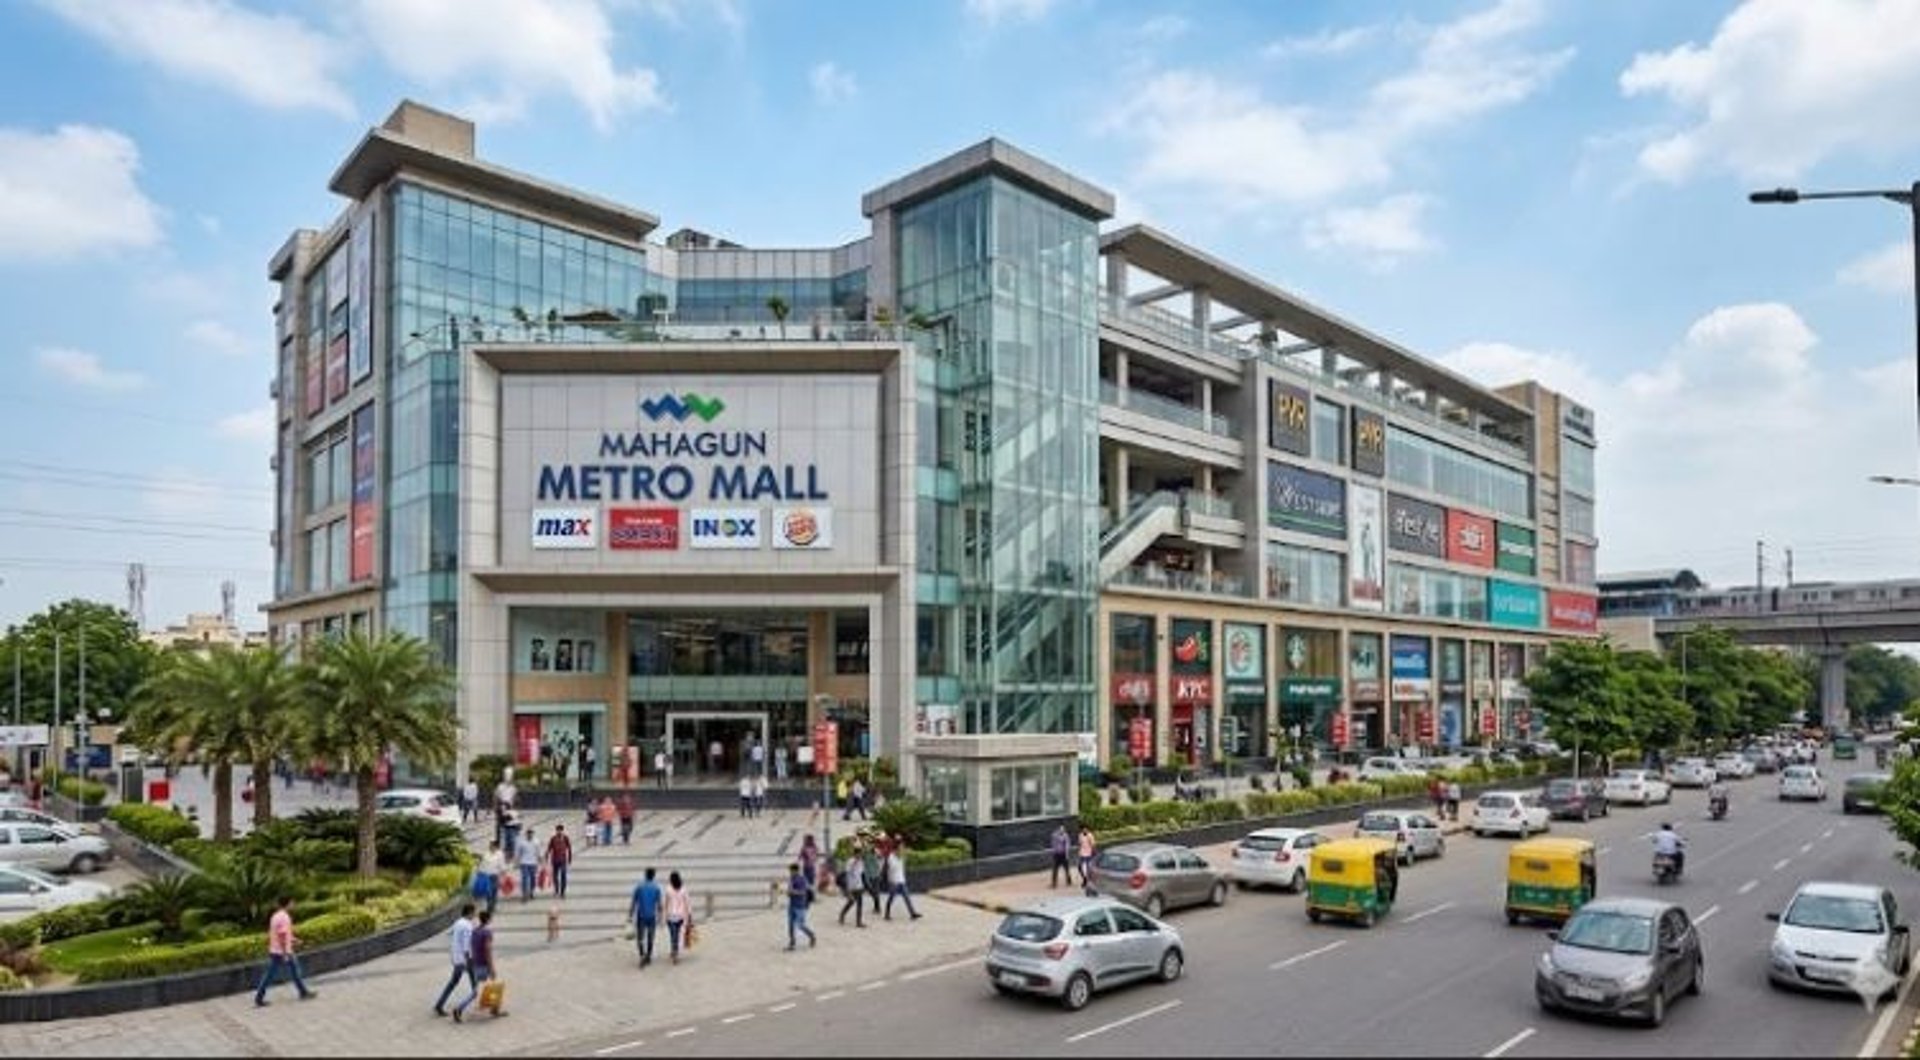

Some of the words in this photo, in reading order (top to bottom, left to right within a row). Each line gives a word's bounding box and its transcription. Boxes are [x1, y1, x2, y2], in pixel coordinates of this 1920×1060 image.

[599, 431, 766, 457] MAHAGUN
[538, 464, 694, 501] METRO
[709, 464, 829, 501] MALL
[536, 518, 592, 537] max
[693, 518, 756, 537] INOX
